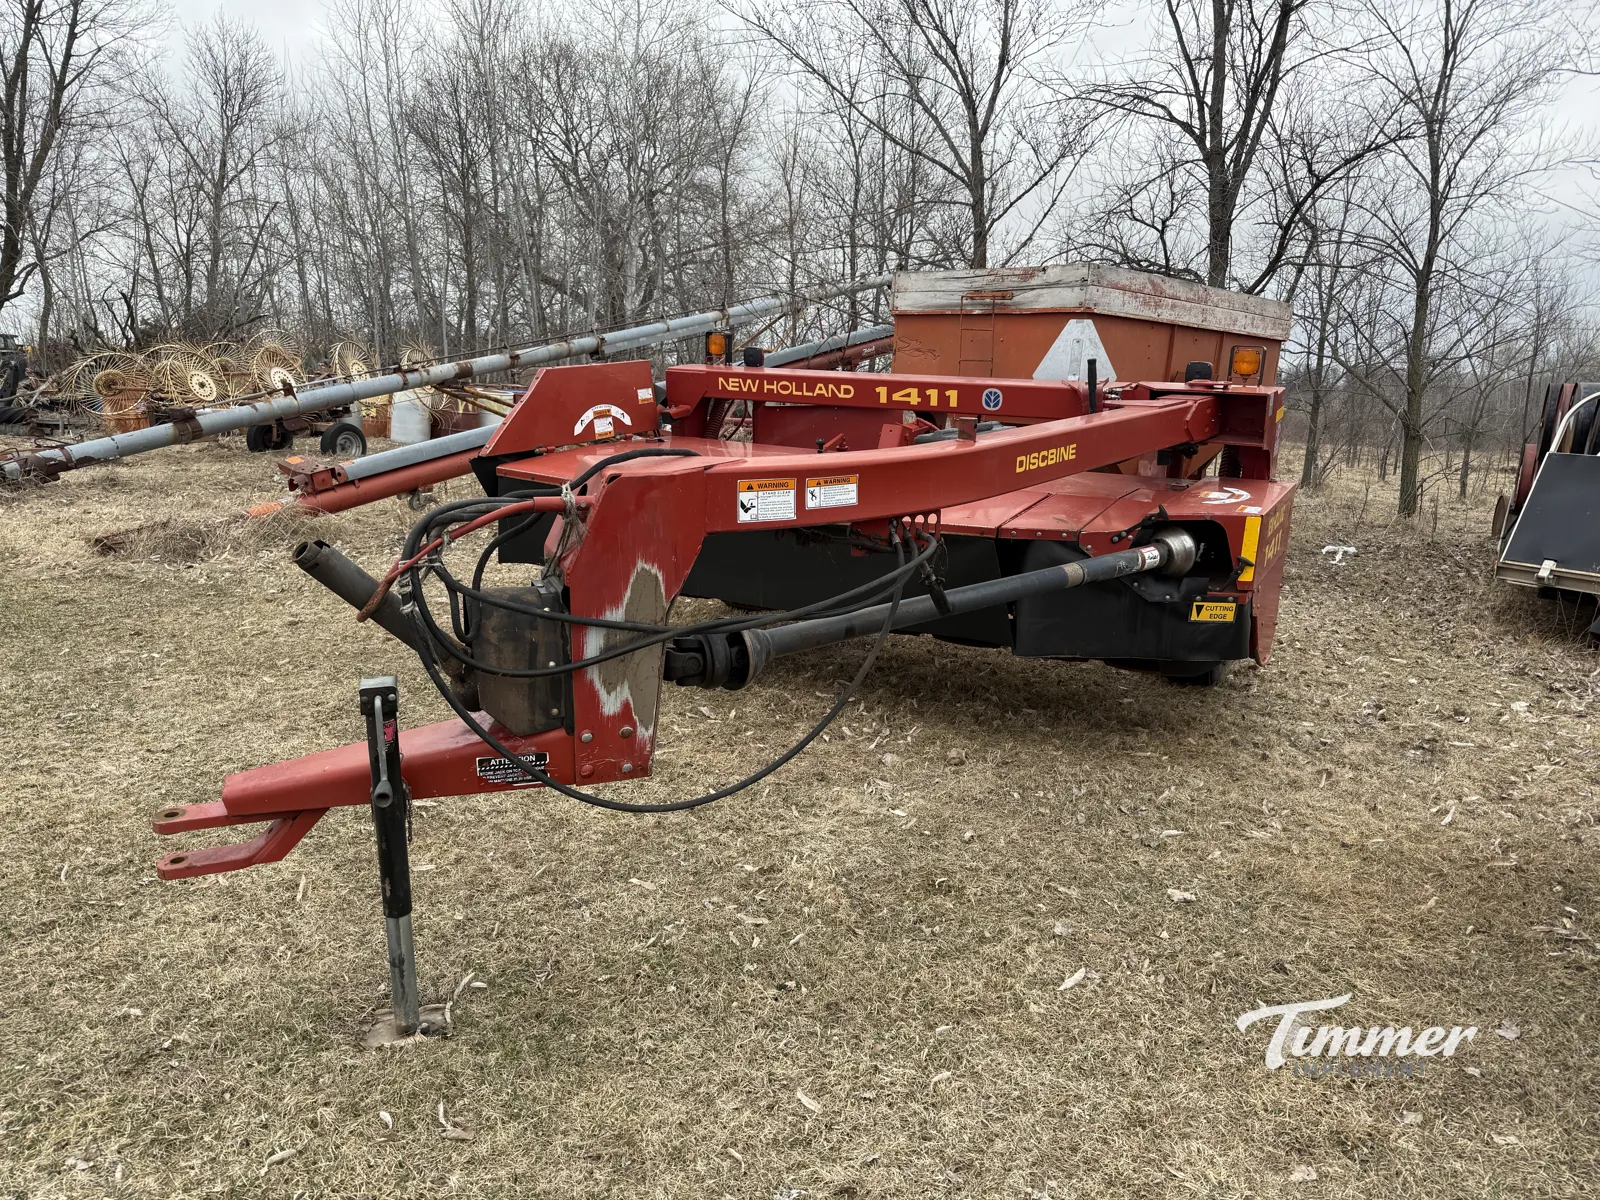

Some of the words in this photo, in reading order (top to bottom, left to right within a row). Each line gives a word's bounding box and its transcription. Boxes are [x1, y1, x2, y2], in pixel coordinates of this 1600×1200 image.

[718, 377, 759, 392] NEW
[763, 380, 855, 399] HOLLAND
[875, 386, 958, 408] 1411
[1015, 443, 1077, 474] DISCBINE
[757, 481, 789, 490] WARNING
[823, 477, 851, 485] WARNING
[490, 755, 536, 766] ATTEION
